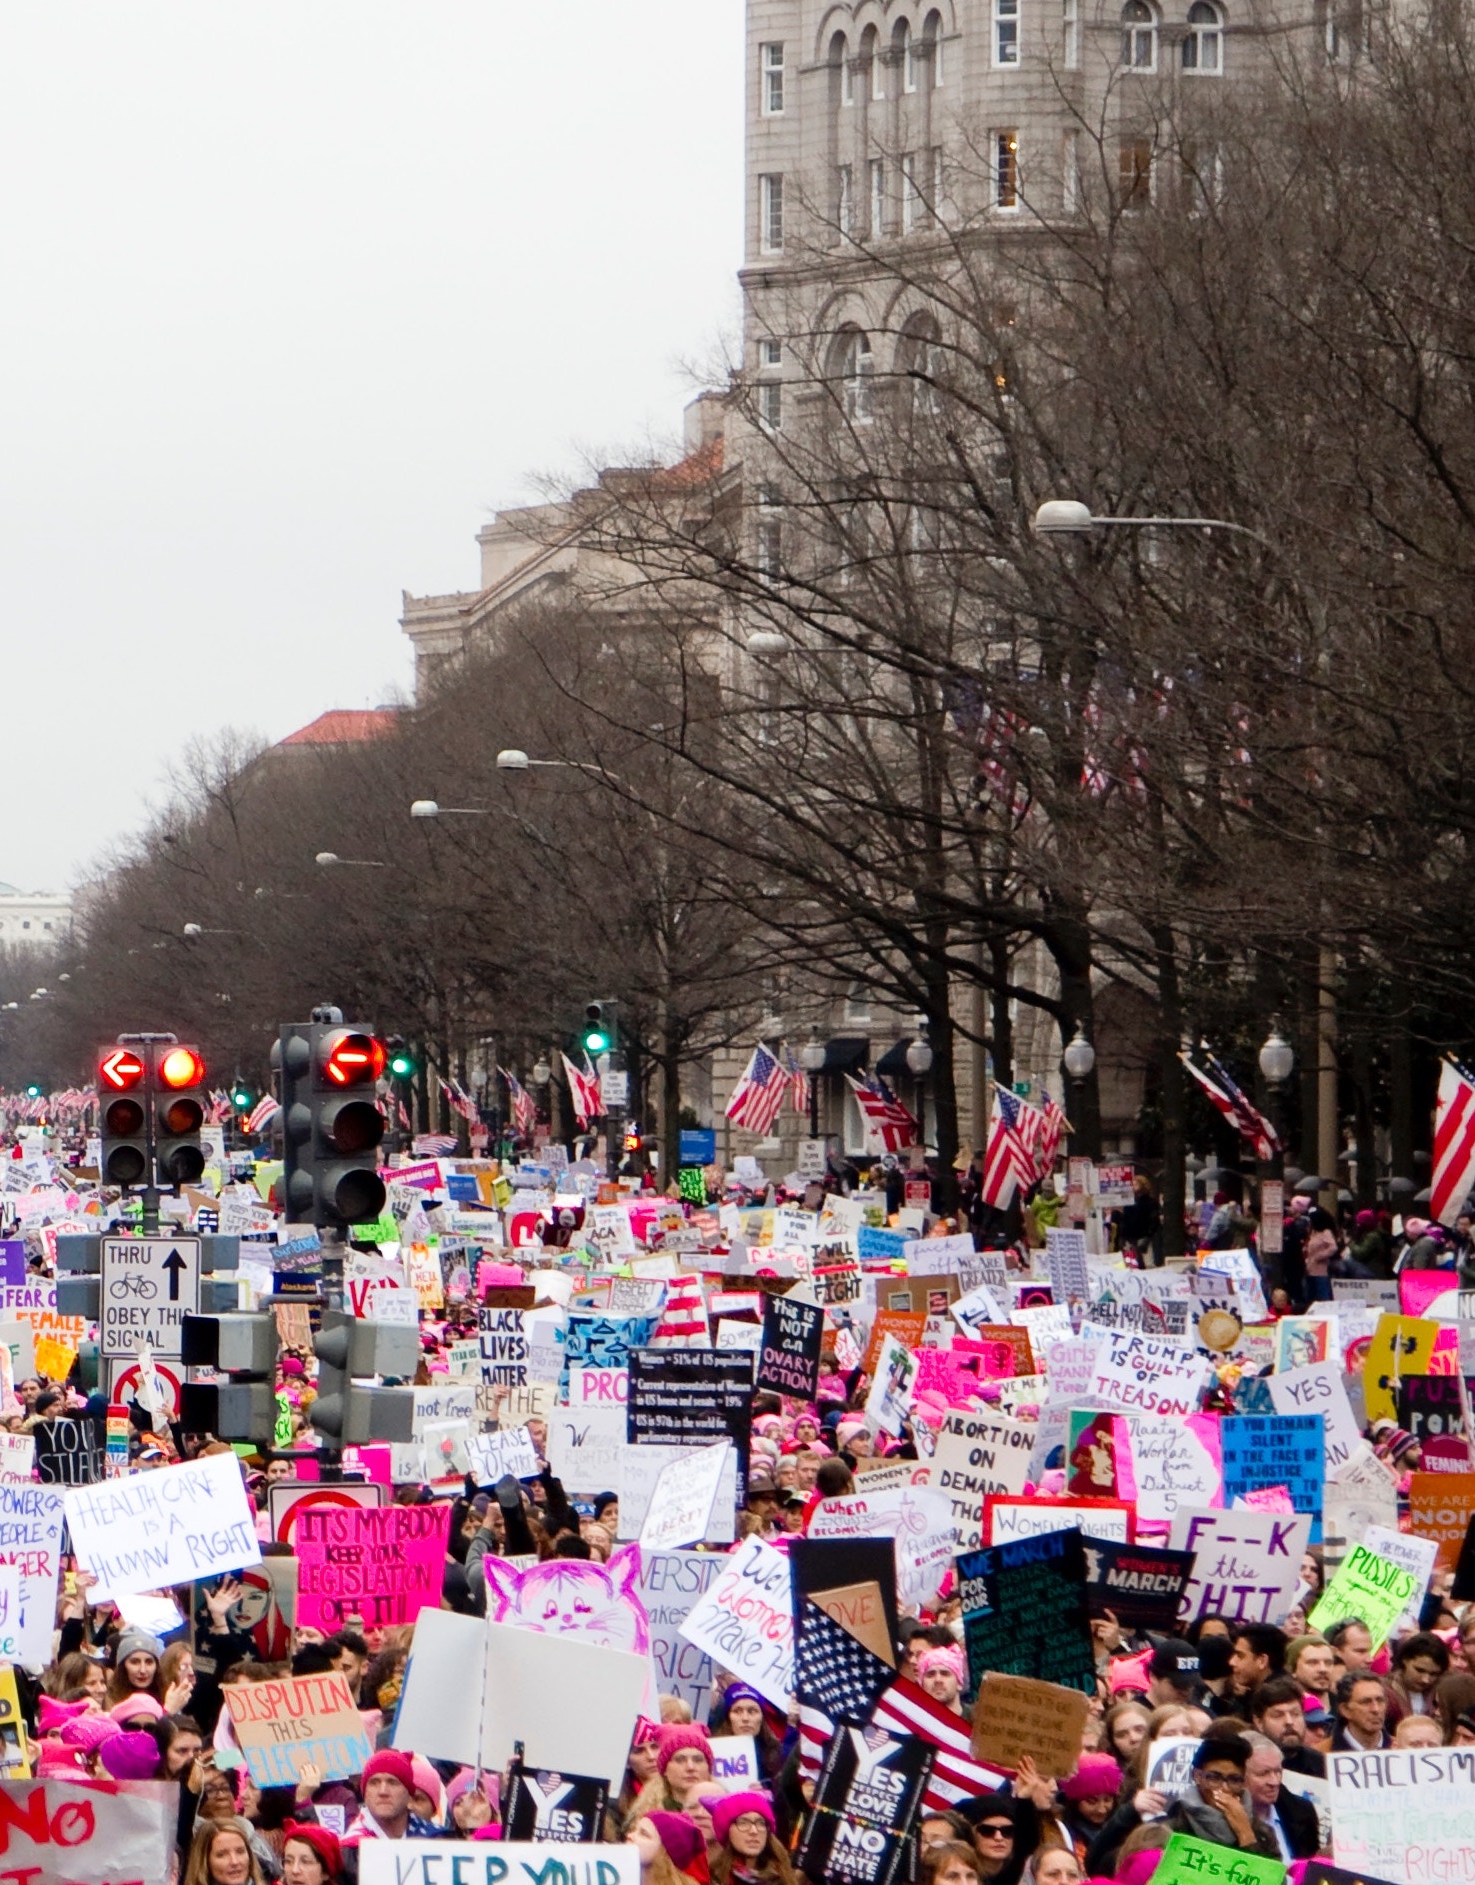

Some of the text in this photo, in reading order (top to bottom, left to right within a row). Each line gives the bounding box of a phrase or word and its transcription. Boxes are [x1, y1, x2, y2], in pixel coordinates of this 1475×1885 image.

[109, 1247, 151, 1265] THRU
[812, 1244, 820, 1258] I
[827, 1241, 853, 1257] WILL
[957, 1256, 1002, 1270] WE ARE
[1206, 1255, 1244, 1271] FUCK
[814, 1278, 863, 1301] FIGHT
[960, 1271, 1006, 1289] GREATER
[6, 1290, 51, 1308] FEAR
[107, 1308, 149, 1326] OBEY
[479, 1309, 524, 1332] BLACK
[778, 1319, 813, 1337] NOT
[480, 1337, 525, 1361] LIVES
[764, 1349, 814, 1371] OVARY
[1110, 1332, 1196, 1365] TRUMP
[481, 1365, 526, 1386] MATTER
[1110, 1351, 1197, 1379] IS GUILTY
[1137, 1369, 1161, 1383] OF
[758, 1366, 813, 1392] ACTION
[1286, 1376, 1332, 1405] YES
[1097, 1377, 1189, 1416] TREASON
[942, 1415, 1037, 1451] ABORTION
[1243, 1419, 1266, 1432] YOU
[1270, 1418, 1316, 1432] REMAIN
[8, 1434, 30, 1450] NOT
[1251, 1434, 1293, 1448] SILENT
[969, 1448, 995, 1470] ON
[1244, 1448, 1317, 1463] THE FACE OF
[858, 1466, 912, 1485] WOMEN'S
[941, 1470, 1009, 1496] DEMAND
[1141, 1475, 1206, 1492] District
[1241, 1465, 1302, 1479] INJUSTICE
[1165, 1493, 1178, 1513] 5
[1414, 1495, 1463, 1506] WE ARE
[144, 1512, 185, 1537] IS A
[301, 1507, 447, 1543] IT'S MY BODY
[1185, 1517, 1297, 1556] F--K
[90, 1521, 252, 1588] HUMAN RIGHT
[1003, 1536, 1066, 1568] MARCH
[1208, 1551, 1260, 1579] this
[1347, 1546, 1413, 1599] PUSSIES
[298, 1565, 430, 1594] LEGISLATION
[960, 1577, 985, 1595] FOR
[1106, 1567, 1183, 1594] MARCH
[962, 1593, 990, 1612] OUR
[1178, 1578, 1282, 1625] SHIT
[227, 1677, 353, 1723] DISPUTIN
[269, 1719, 313, 1743] THIS
[848, 1727, 907, 1794] YES
[1334, 1754, 1475, 1789] RACISM
[851, 1784, 900, 1802] RESPECT
[844, 1804, 894, 1825] EQUALITY
[846, 1793, 898, 1817] LOVE
[835, 1820, 887, 1853] NO
[832, 1848, 879, 1876] HATE
[834, 1842, 881, 1863] RACISM
[828, 1860, 875, 1883] SEXISM
